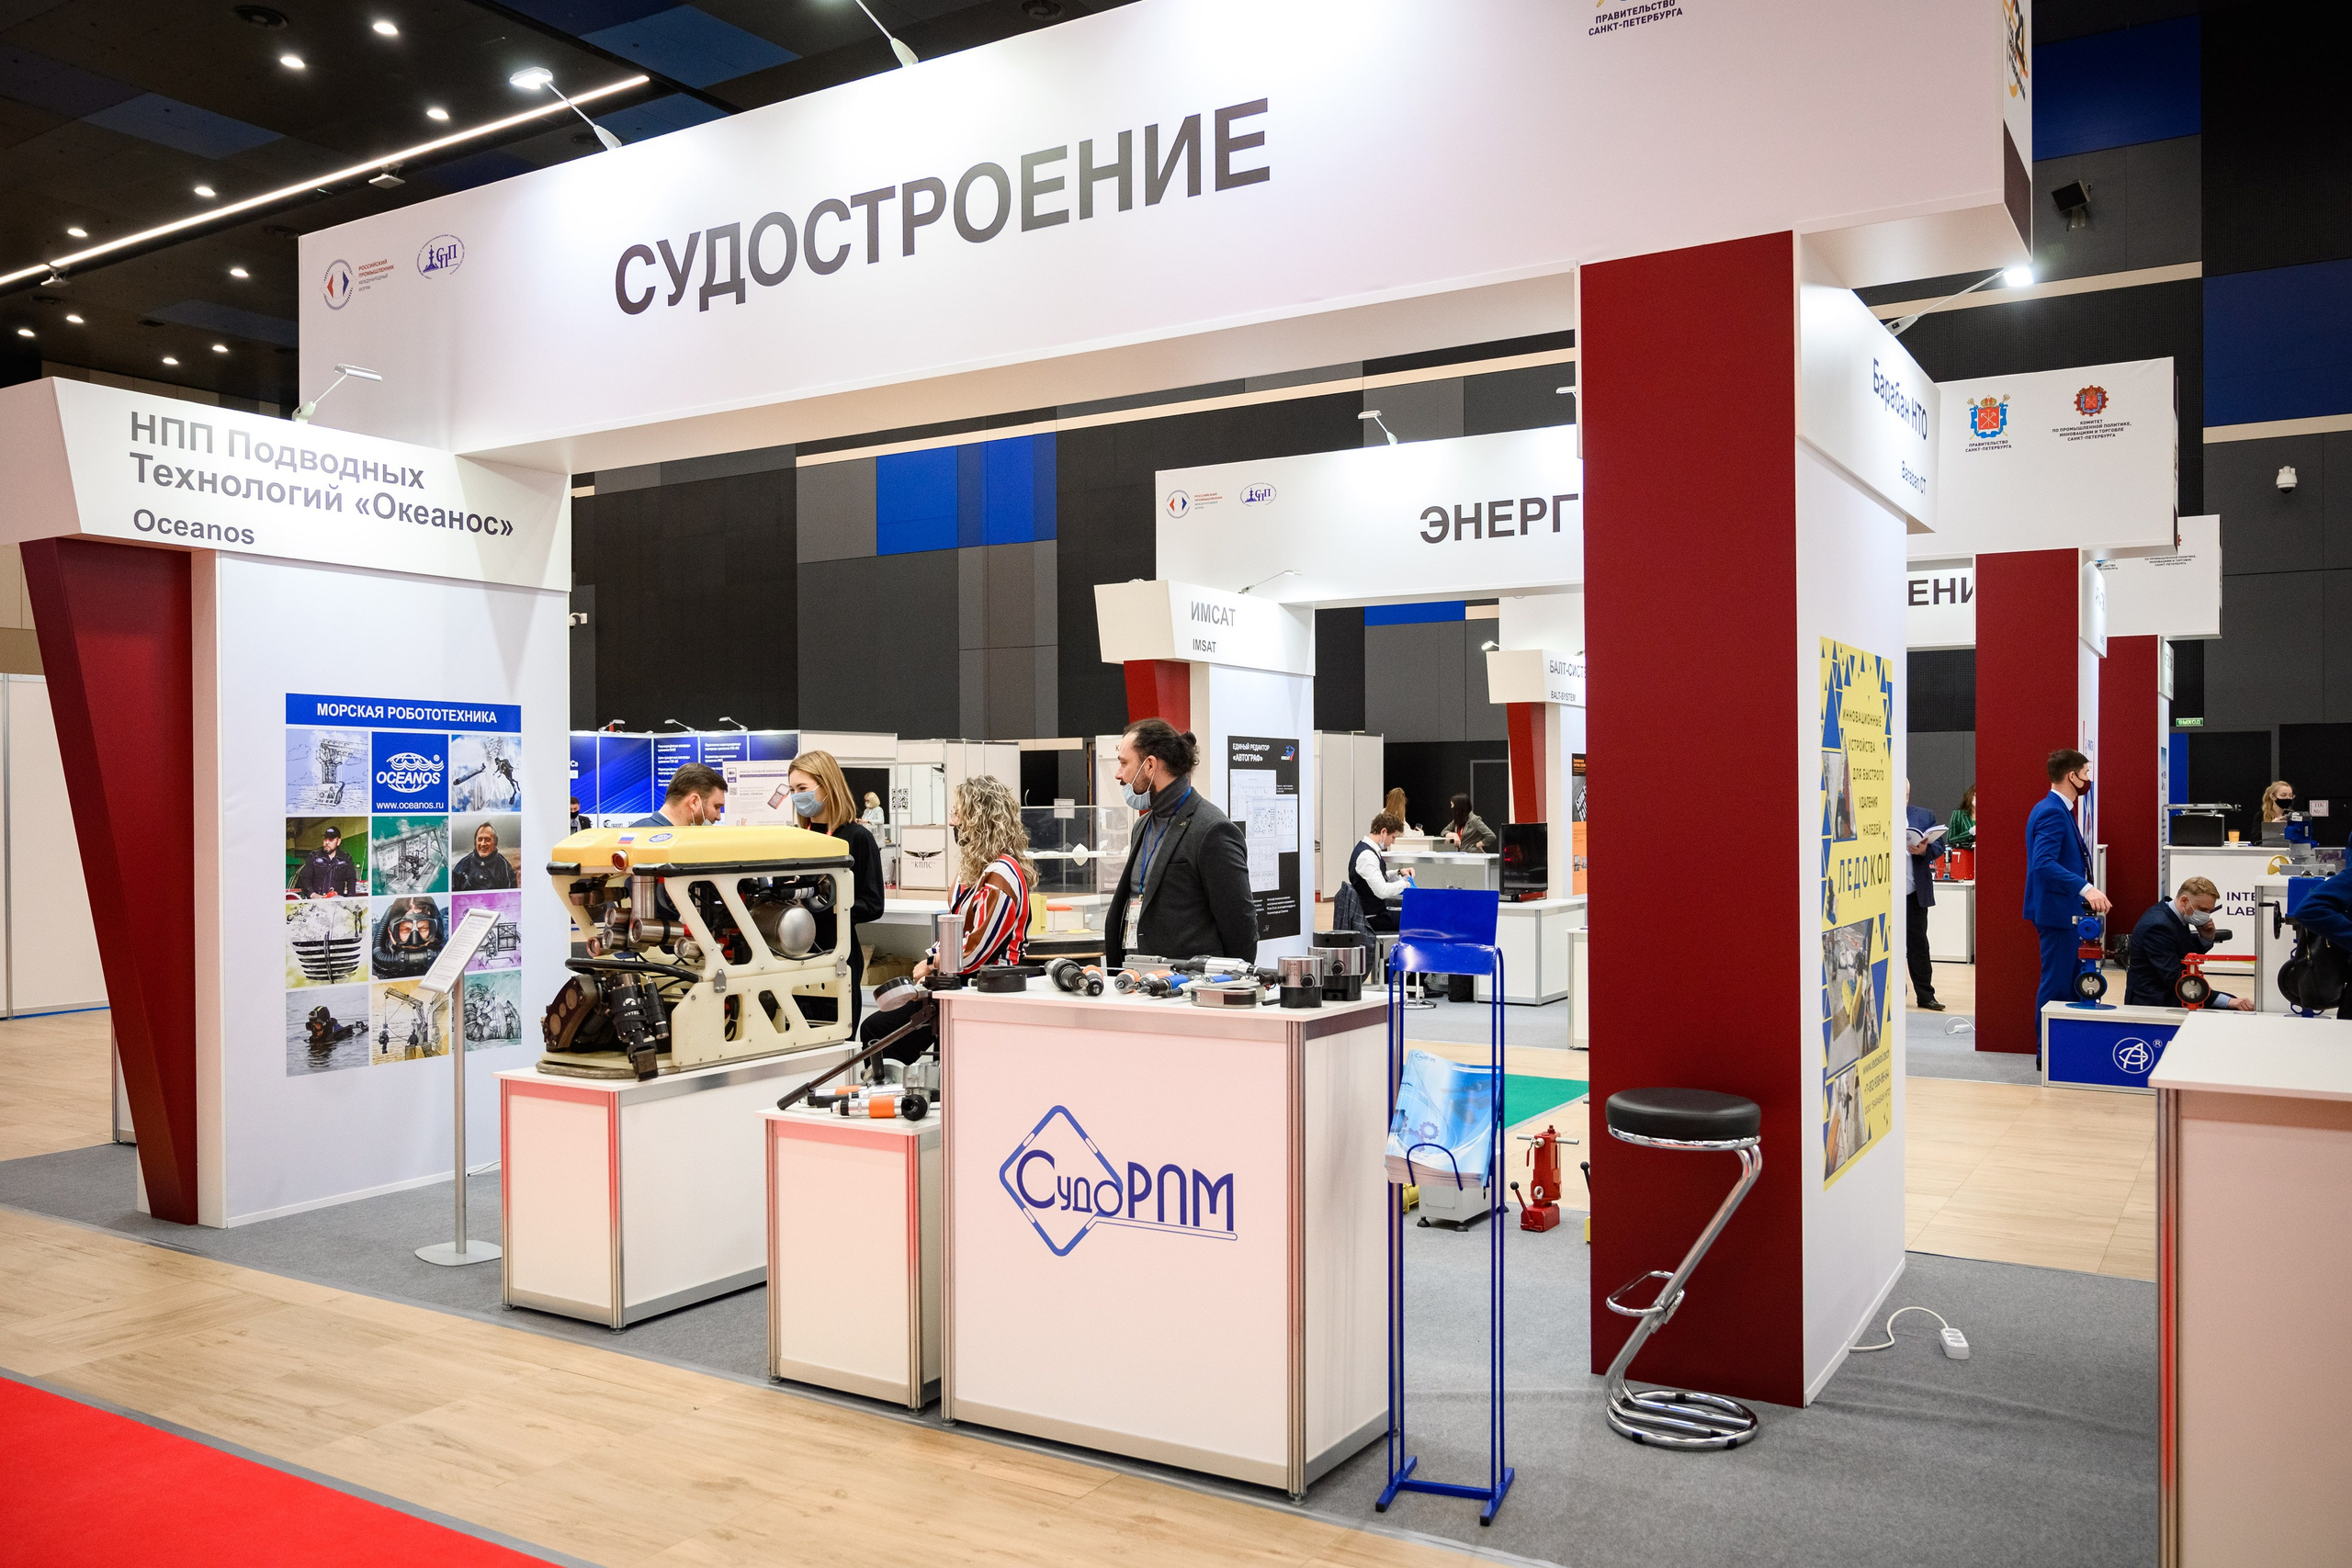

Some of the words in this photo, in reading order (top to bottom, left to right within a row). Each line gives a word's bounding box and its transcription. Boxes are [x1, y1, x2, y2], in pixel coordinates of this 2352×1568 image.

[1589, 7, 1683, 36] САНКТ-ПЕТЕРБУРГА
[1595, 0, 1676, 24] ПРАВИТЕЛЬСТВО
[615, 97, 1271, 315] СУДОСТРОЕНИЕ
[1873, 357, 1909, 424] Барабан
[1911, 397, 1928, 441] НТО
[2060, 424, 2103, 433] ПРОМЫШЛЕННОЙ
[130, 412, 213, 454] НПП
[228, 429, 424, 490] Подводных
[130, 452, 343, 513] Технологий
[356, 492, 514, 537] «Океанос»
[132, 509, 255, 545] Oceanos
[1419, 493, 1579, 545] ЭНЕРГ
[1191, 601, 1236, 627] ИМСАТ
[1193, 638, 1216, 654] IMSAT
[1551, 690, 1577, 702] BALT-SYSTEM
[317, 703, 384, 718] МОРСКАЯ
[388, 706, 497, 723] РОБОТОТЕХНИКА
[1232, 742, 1250, 750] ЕДИНЫЙ
[1250, 743, 1270, 751] РЕДАКТОР
[1849, 738, 1876, 753] УСТРОЙСТВА
[1232, 753, 1263, 762] «АВТОГРАФ»
[376, 771, 441, 785] OCEANOS
[1862, 768, 1884, 781] БЫСТРОГО
[376, 801, 444, 810] www.oceanos.ru
[1838, 852, 1890, 899] ЛЕДОКОЛ
[2227, 906, 2256, 916] LAB
